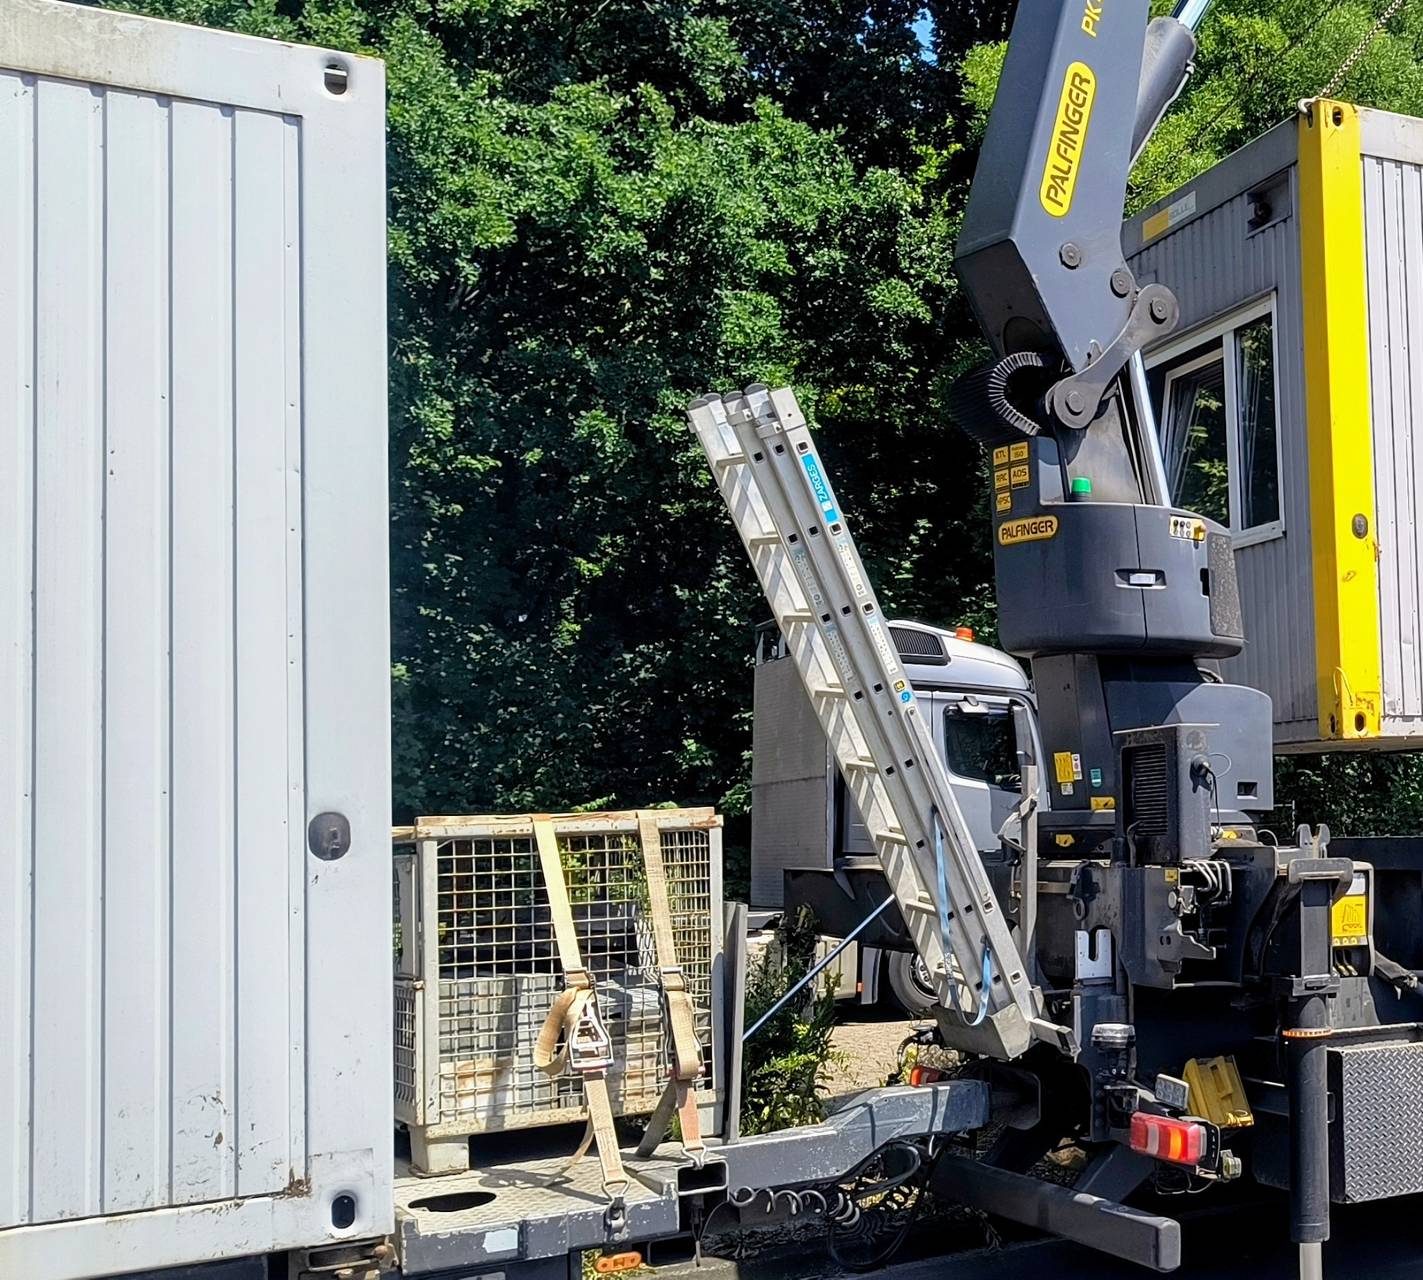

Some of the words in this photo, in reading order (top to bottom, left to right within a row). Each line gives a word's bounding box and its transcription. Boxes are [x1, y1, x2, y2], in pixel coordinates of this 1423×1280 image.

[1045, 71, 1091, 208] PALFINGER
[807, 464, 828, 502] ZARGES
[1001, 520, 1054, 540] PALFINGER
